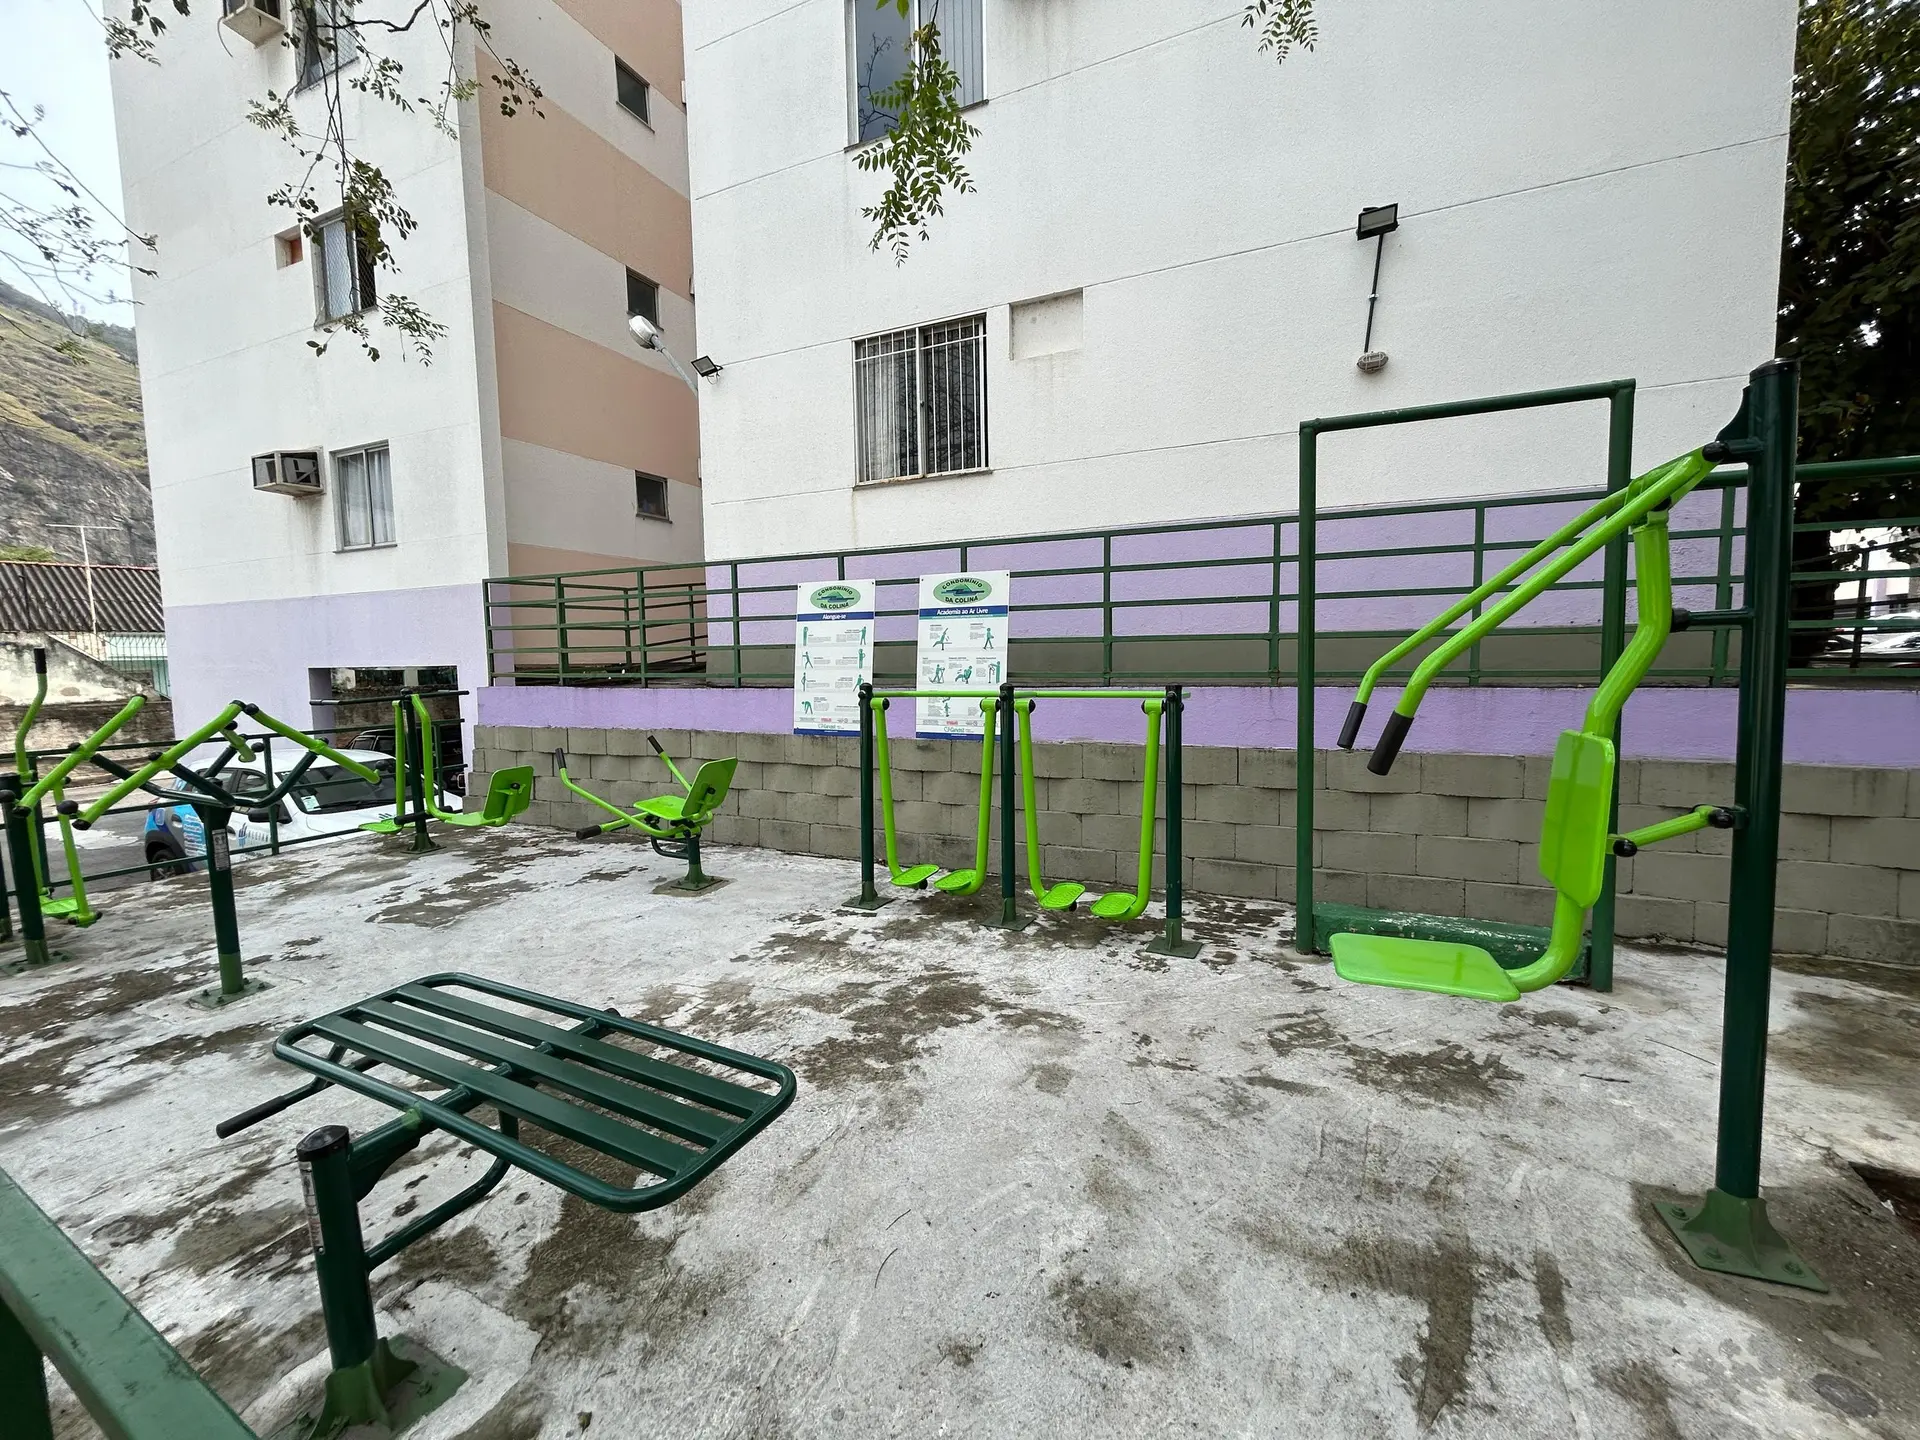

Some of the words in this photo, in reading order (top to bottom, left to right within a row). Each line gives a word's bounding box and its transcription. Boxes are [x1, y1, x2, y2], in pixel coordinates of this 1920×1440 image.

[942, 578, 982, 590] CONDOMÍNIO
[818, 586, 852, 596] CONDOMÍNIO
[954, 596, 978, 604] COLINA
